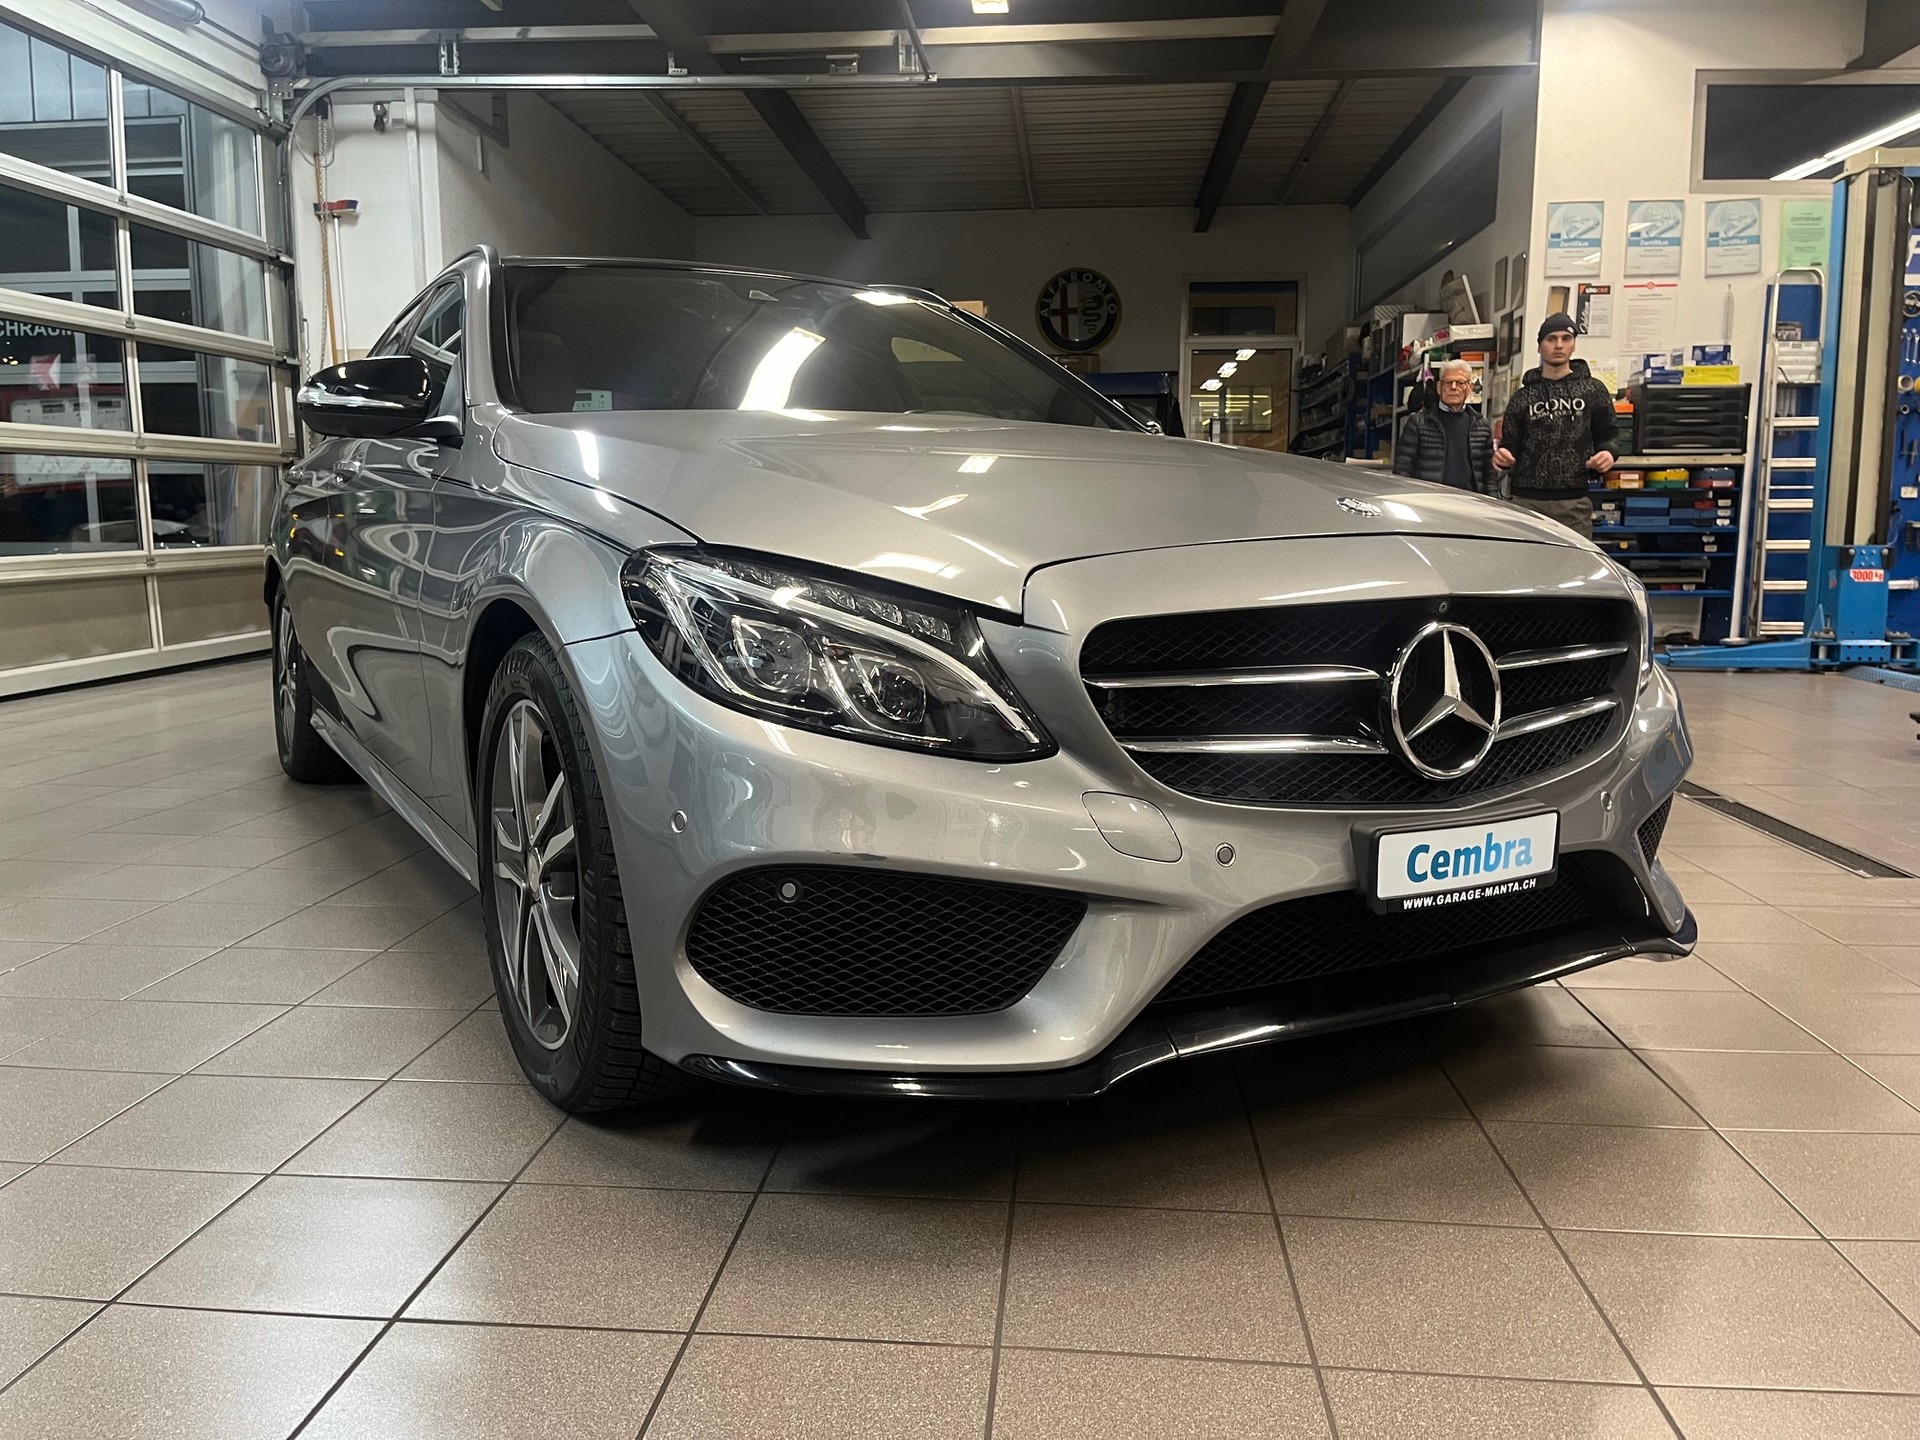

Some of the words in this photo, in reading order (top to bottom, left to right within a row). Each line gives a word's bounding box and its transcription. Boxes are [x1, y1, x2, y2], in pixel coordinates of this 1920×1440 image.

[1529, 398, 1585, 416] ICONO
[1852, 570, 1873, 580] 3000
[1407, 832, 1533, 883] Cembra
[1403, 878, 1537, 910] WWW.GARAGE-MANTA.CH
